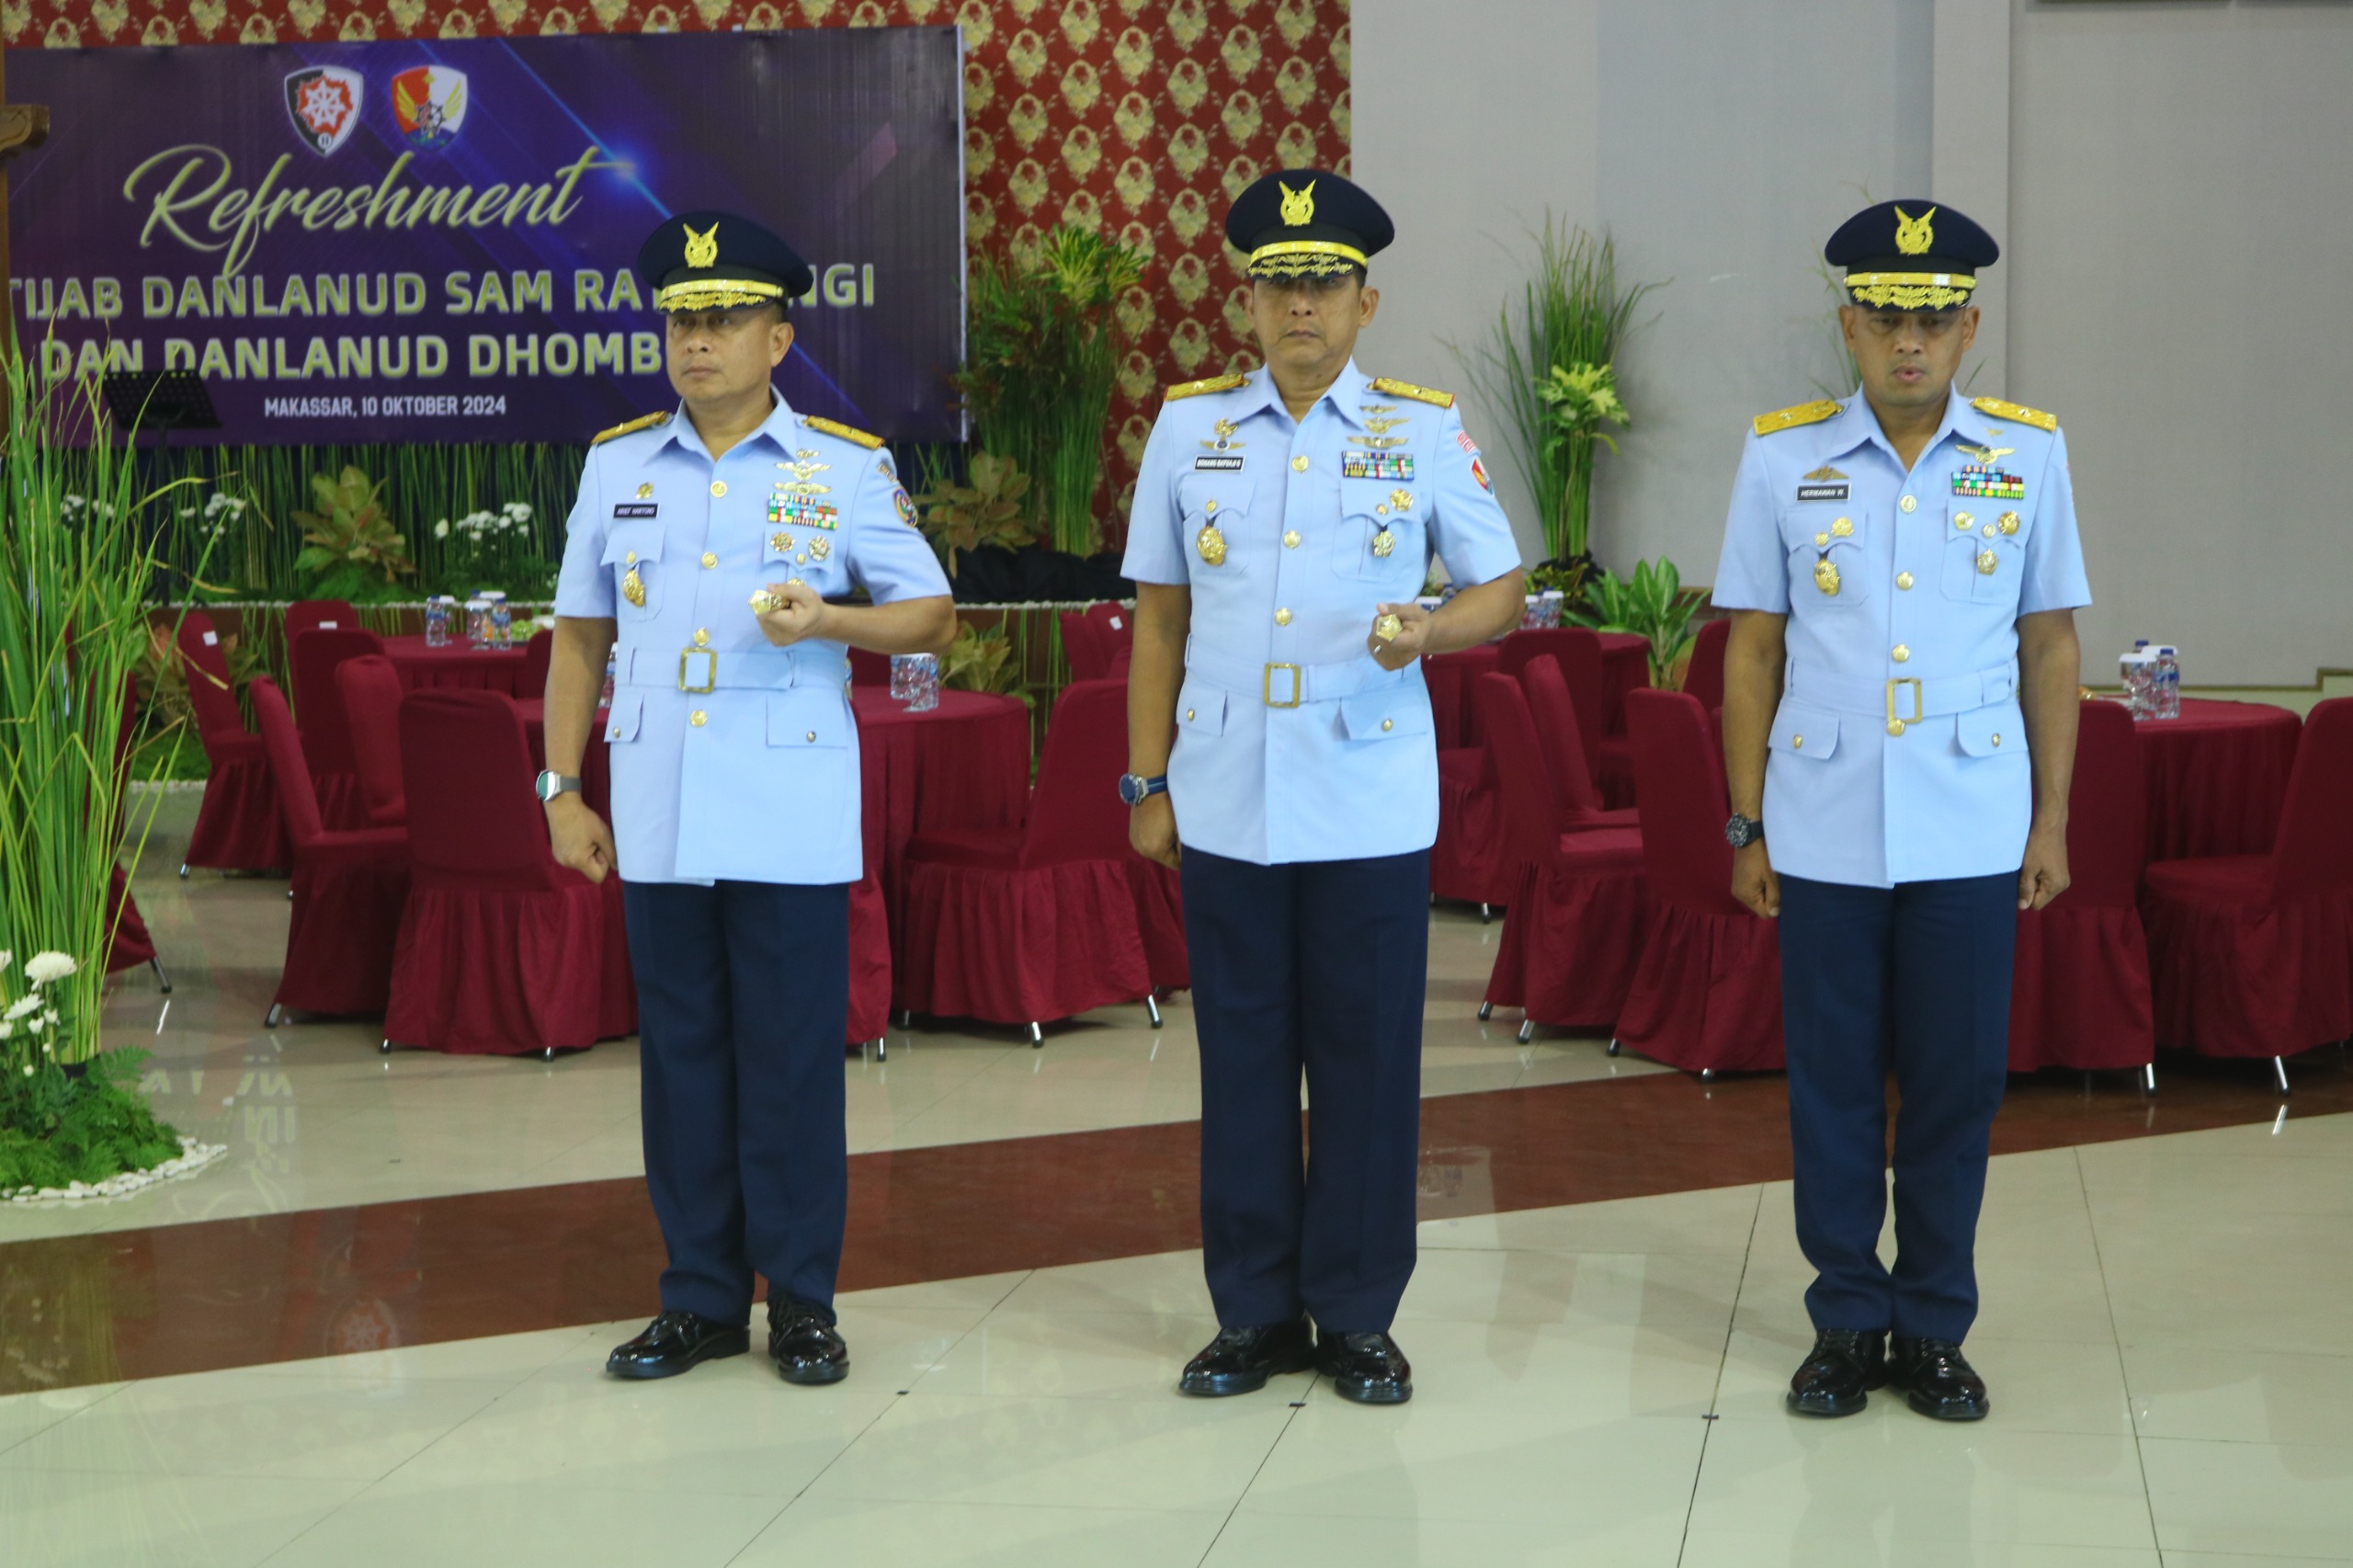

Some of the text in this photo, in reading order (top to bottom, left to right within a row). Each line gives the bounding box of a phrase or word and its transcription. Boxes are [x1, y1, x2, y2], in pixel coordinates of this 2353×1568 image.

[122, 144, 637, 278] Refreshment
[142, 272, 426, 319] DANLANUD
[445, 270, 552, 316] SAM
[40, 331, 662, 382] DAN DANLANUD DHOMB
[265, 395, 506, 418] MAKASSAR, 10 OKTOBER 2024
